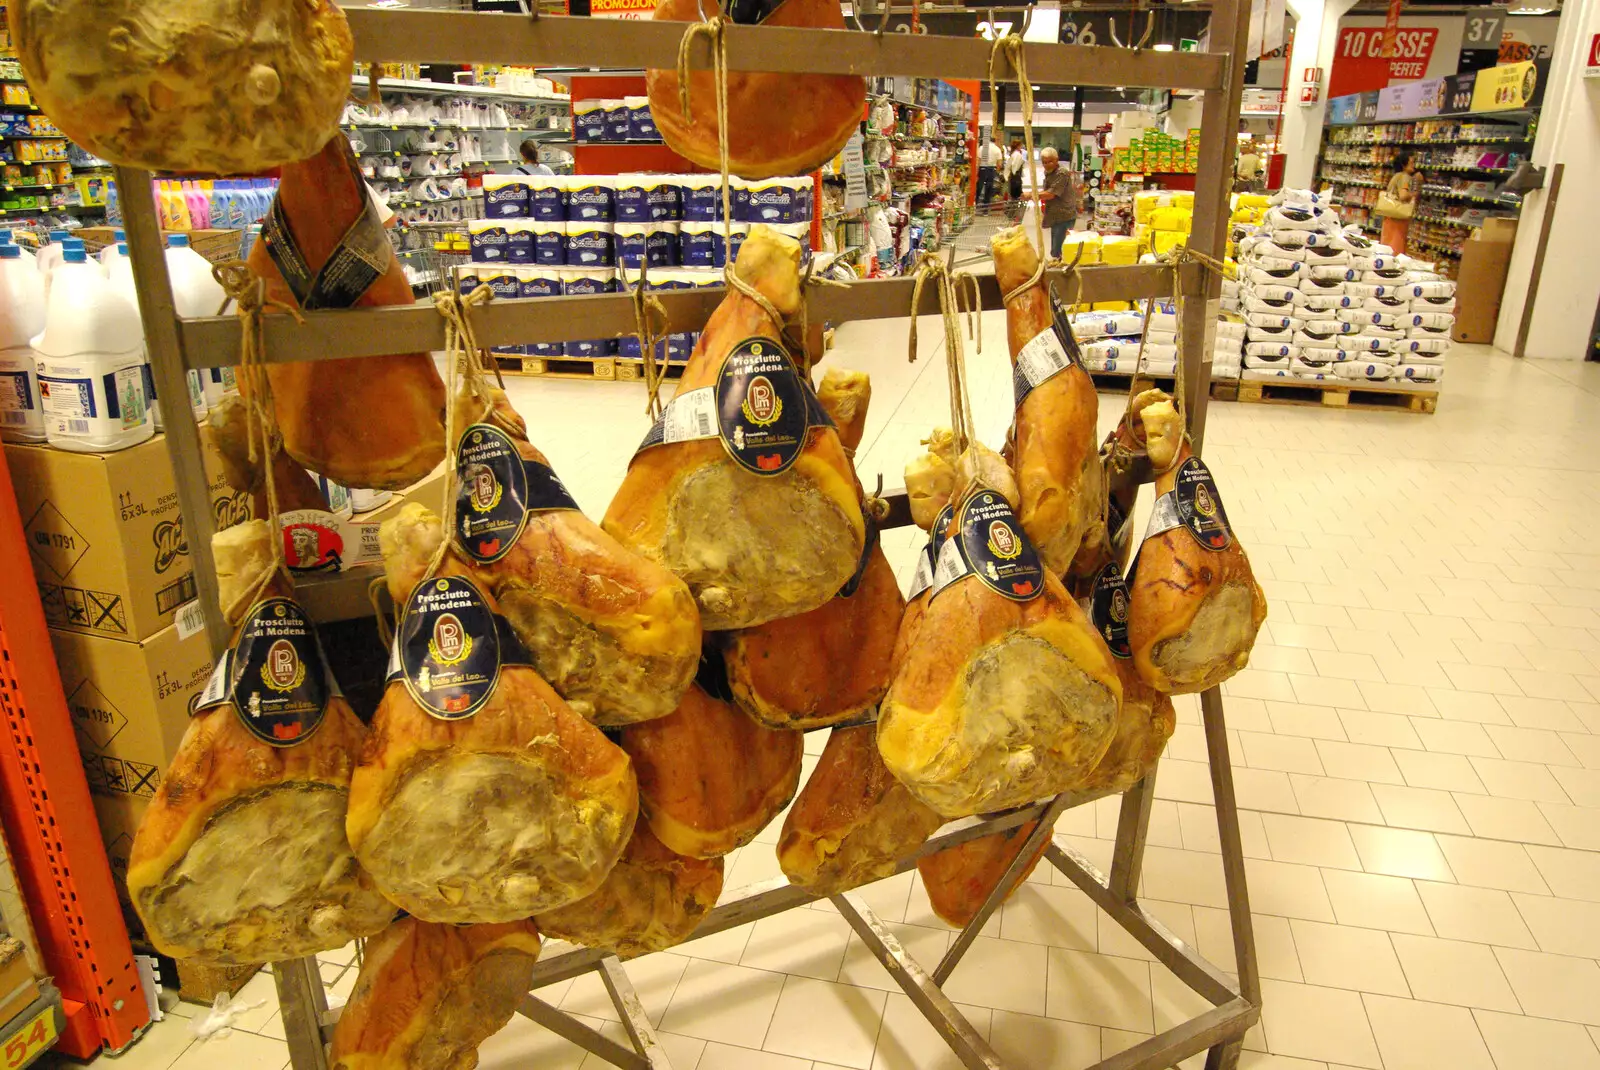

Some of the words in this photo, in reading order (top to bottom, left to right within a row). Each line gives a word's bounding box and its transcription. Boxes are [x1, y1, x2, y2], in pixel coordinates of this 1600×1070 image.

[592, 0, 657, 9] PROMOZION
[976, 22, 1012, 40] 37
[1060, 22, 1097, 46] 36
[1468, 18, 1499, 42] 37
[1344, 32, 1366, 57] 10
[1368, 32, 1432, 58] CSSE
[1390, 62, 1424, 76] PERTE
[734, 354, 781, 366] Prosciutto
[744, 363, 782, 374] Modena
[463, 441, 500, 457] Prosciutto
[469, 450, 502, 463] Modena
[150, 501, 178, 516] PROFUM
[214, 490, 251, 532] ACE
[970, 503, 1008, 514] Prosciutto
[982, 510, 1012, 520] Modena
[35, 532, 50, 546] UN
[52, 534, 76, 550] 1791
[154, 513, 188, 573] AC
[418, 590, 470, 603] Prosciutto
[419, 604, 428, 613] di
[430, 600, 472, 612] Modena
[254, 618, 304, 628] Prosciutto
[254, 628, 264, 636] di
[266, 627, 306, 636] Modena
[191, 662, 212, 678] DENSO
[184, 670, 214, 691] PROFUMA
[452, 674, 464, 682] del
[92, 708, 114, 724] 1791
[6, 1019, 48, 1068] 54
